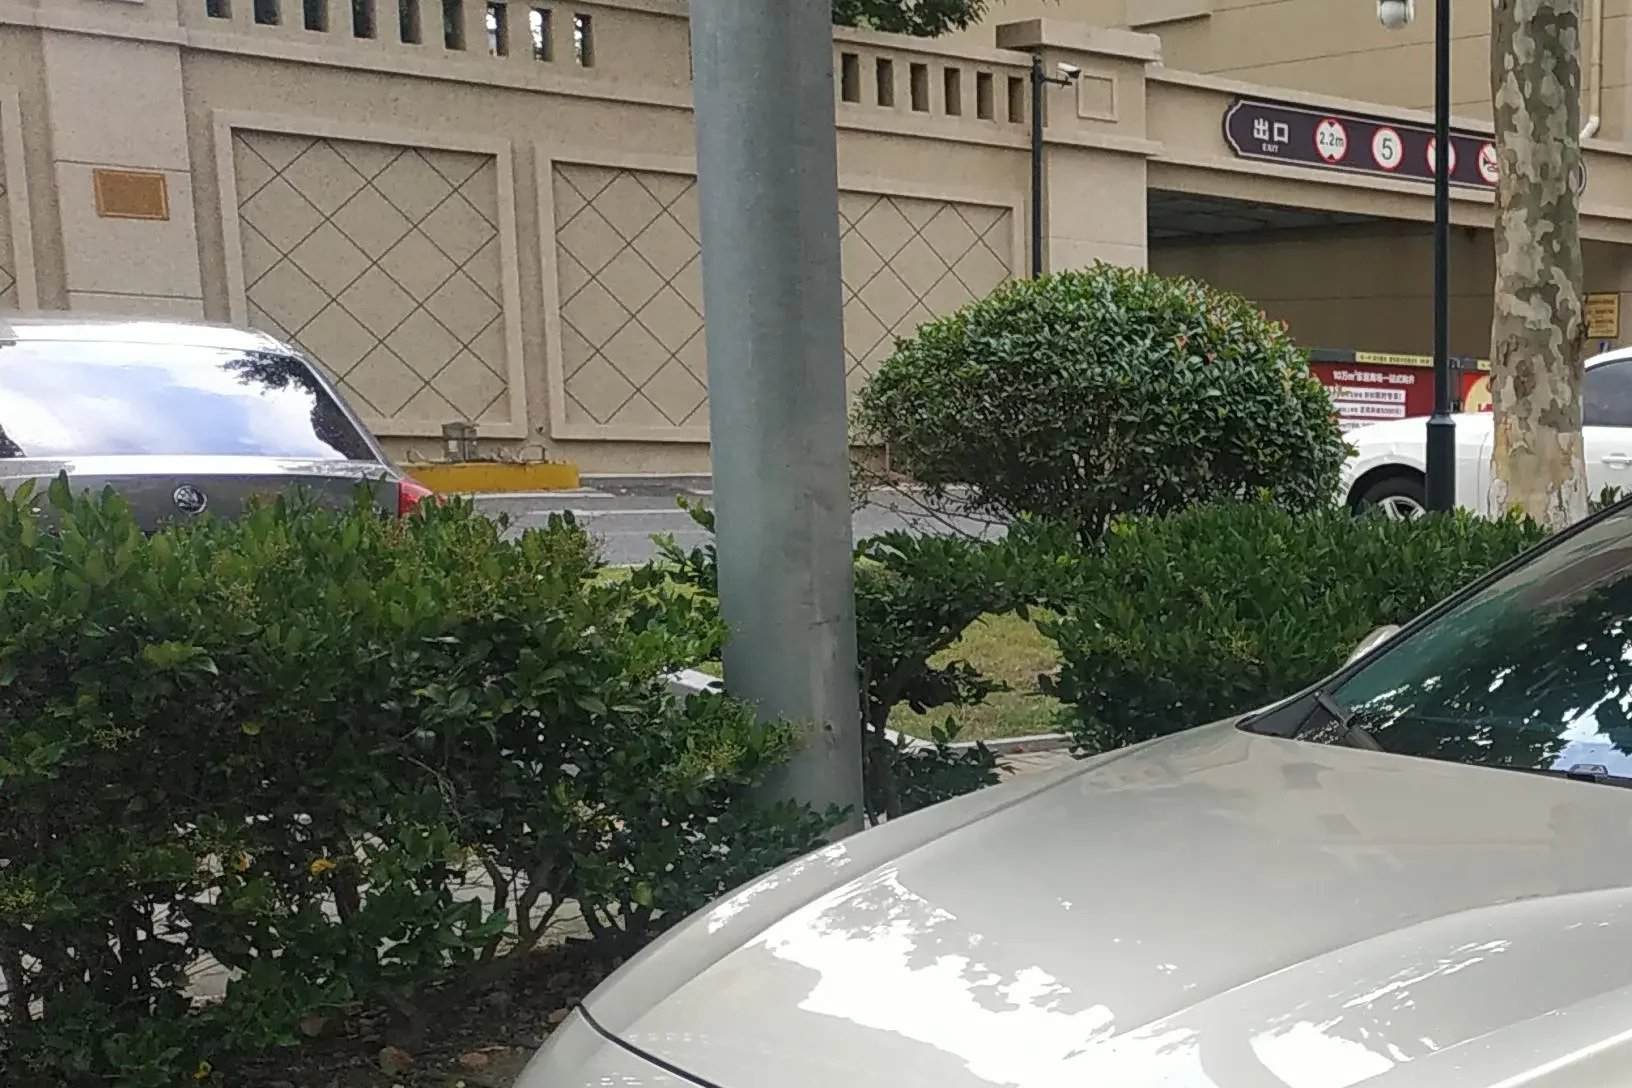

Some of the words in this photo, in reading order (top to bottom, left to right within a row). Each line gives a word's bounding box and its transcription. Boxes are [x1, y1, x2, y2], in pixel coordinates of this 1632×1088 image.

[1253, 118, 1289, 144] 出口
[1319, 131, 1345, 148] 2.2m
[1261, 143, 1279, 153] EXIT
[1380, 137, 1394, 161] 5
